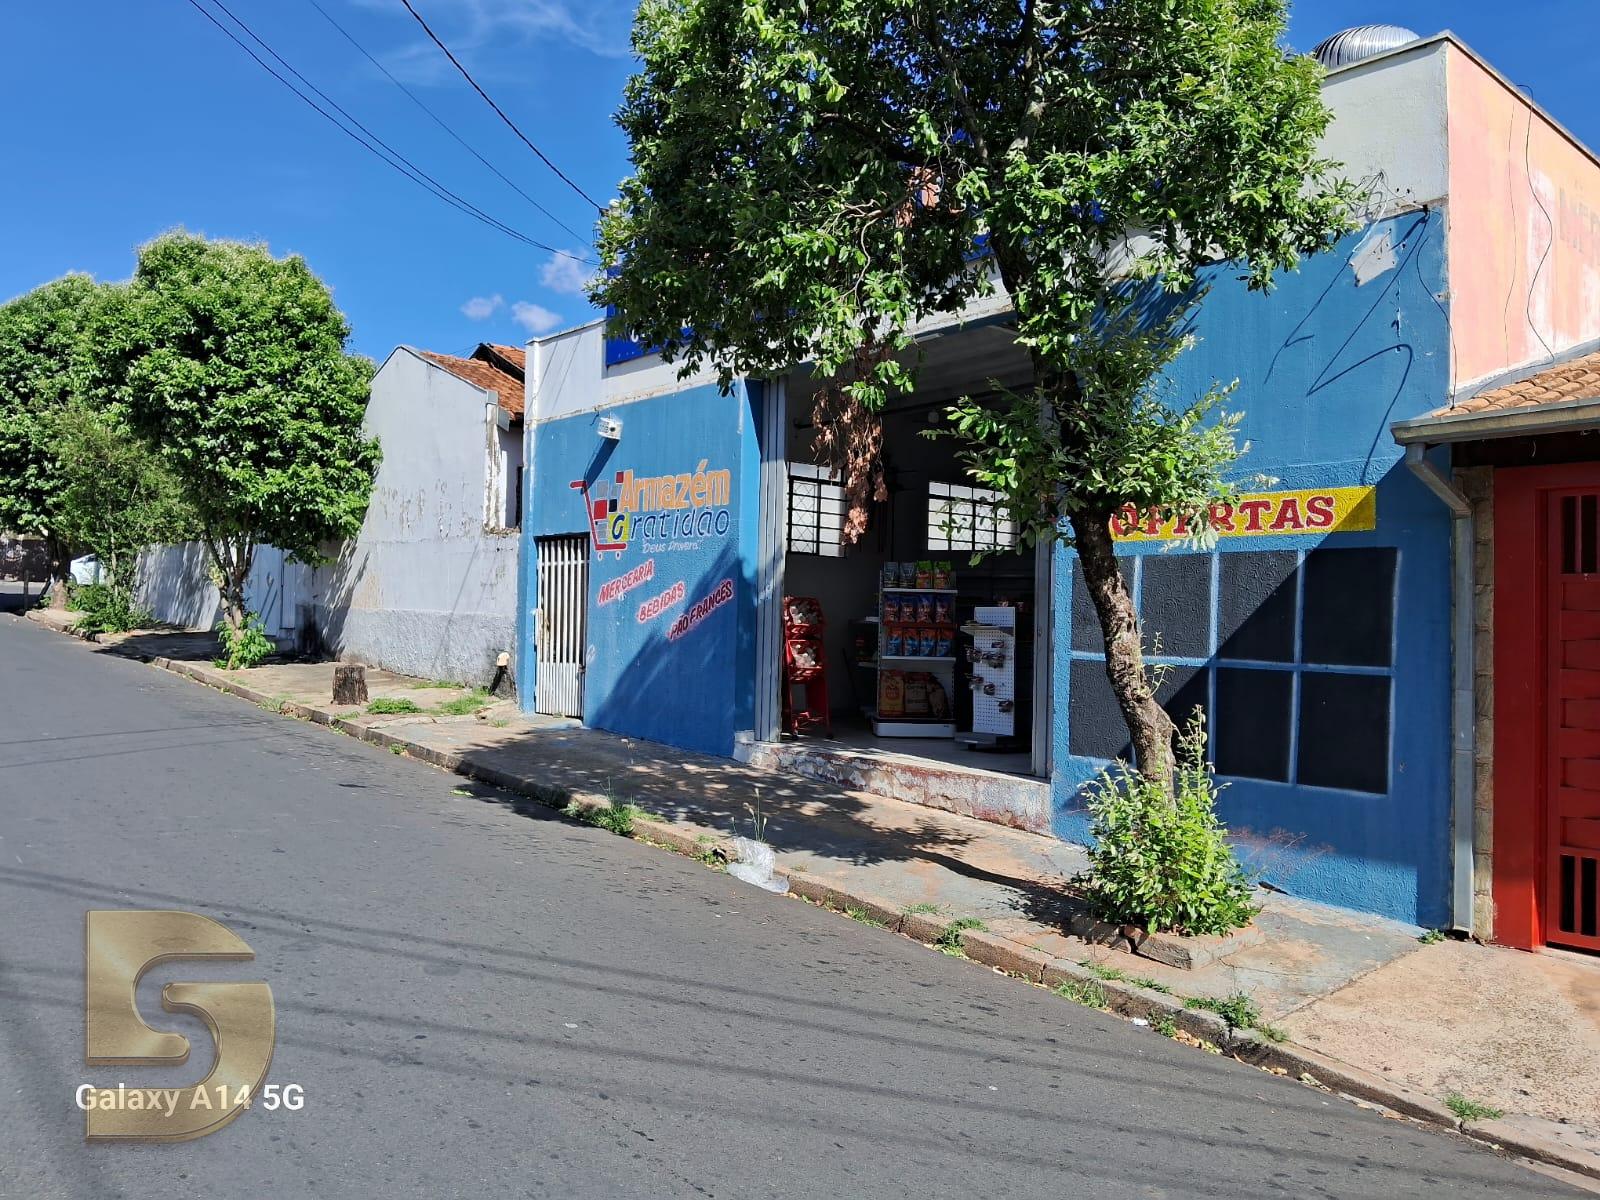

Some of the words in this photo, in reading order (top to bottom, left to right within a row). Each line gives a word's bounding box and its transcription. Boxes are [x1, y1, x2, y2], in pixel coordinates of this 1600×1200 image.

[619, 459, 731, 512] Armazém
[611, 506, 730, 541] Gratidão
[598, 560, 654, 605] MERCEARIA
[638, 582, 685, 622] BEBIDAS
[669, 614, 689, 640] PÃO
[689, 580, 733, 625] FRANCÊS
